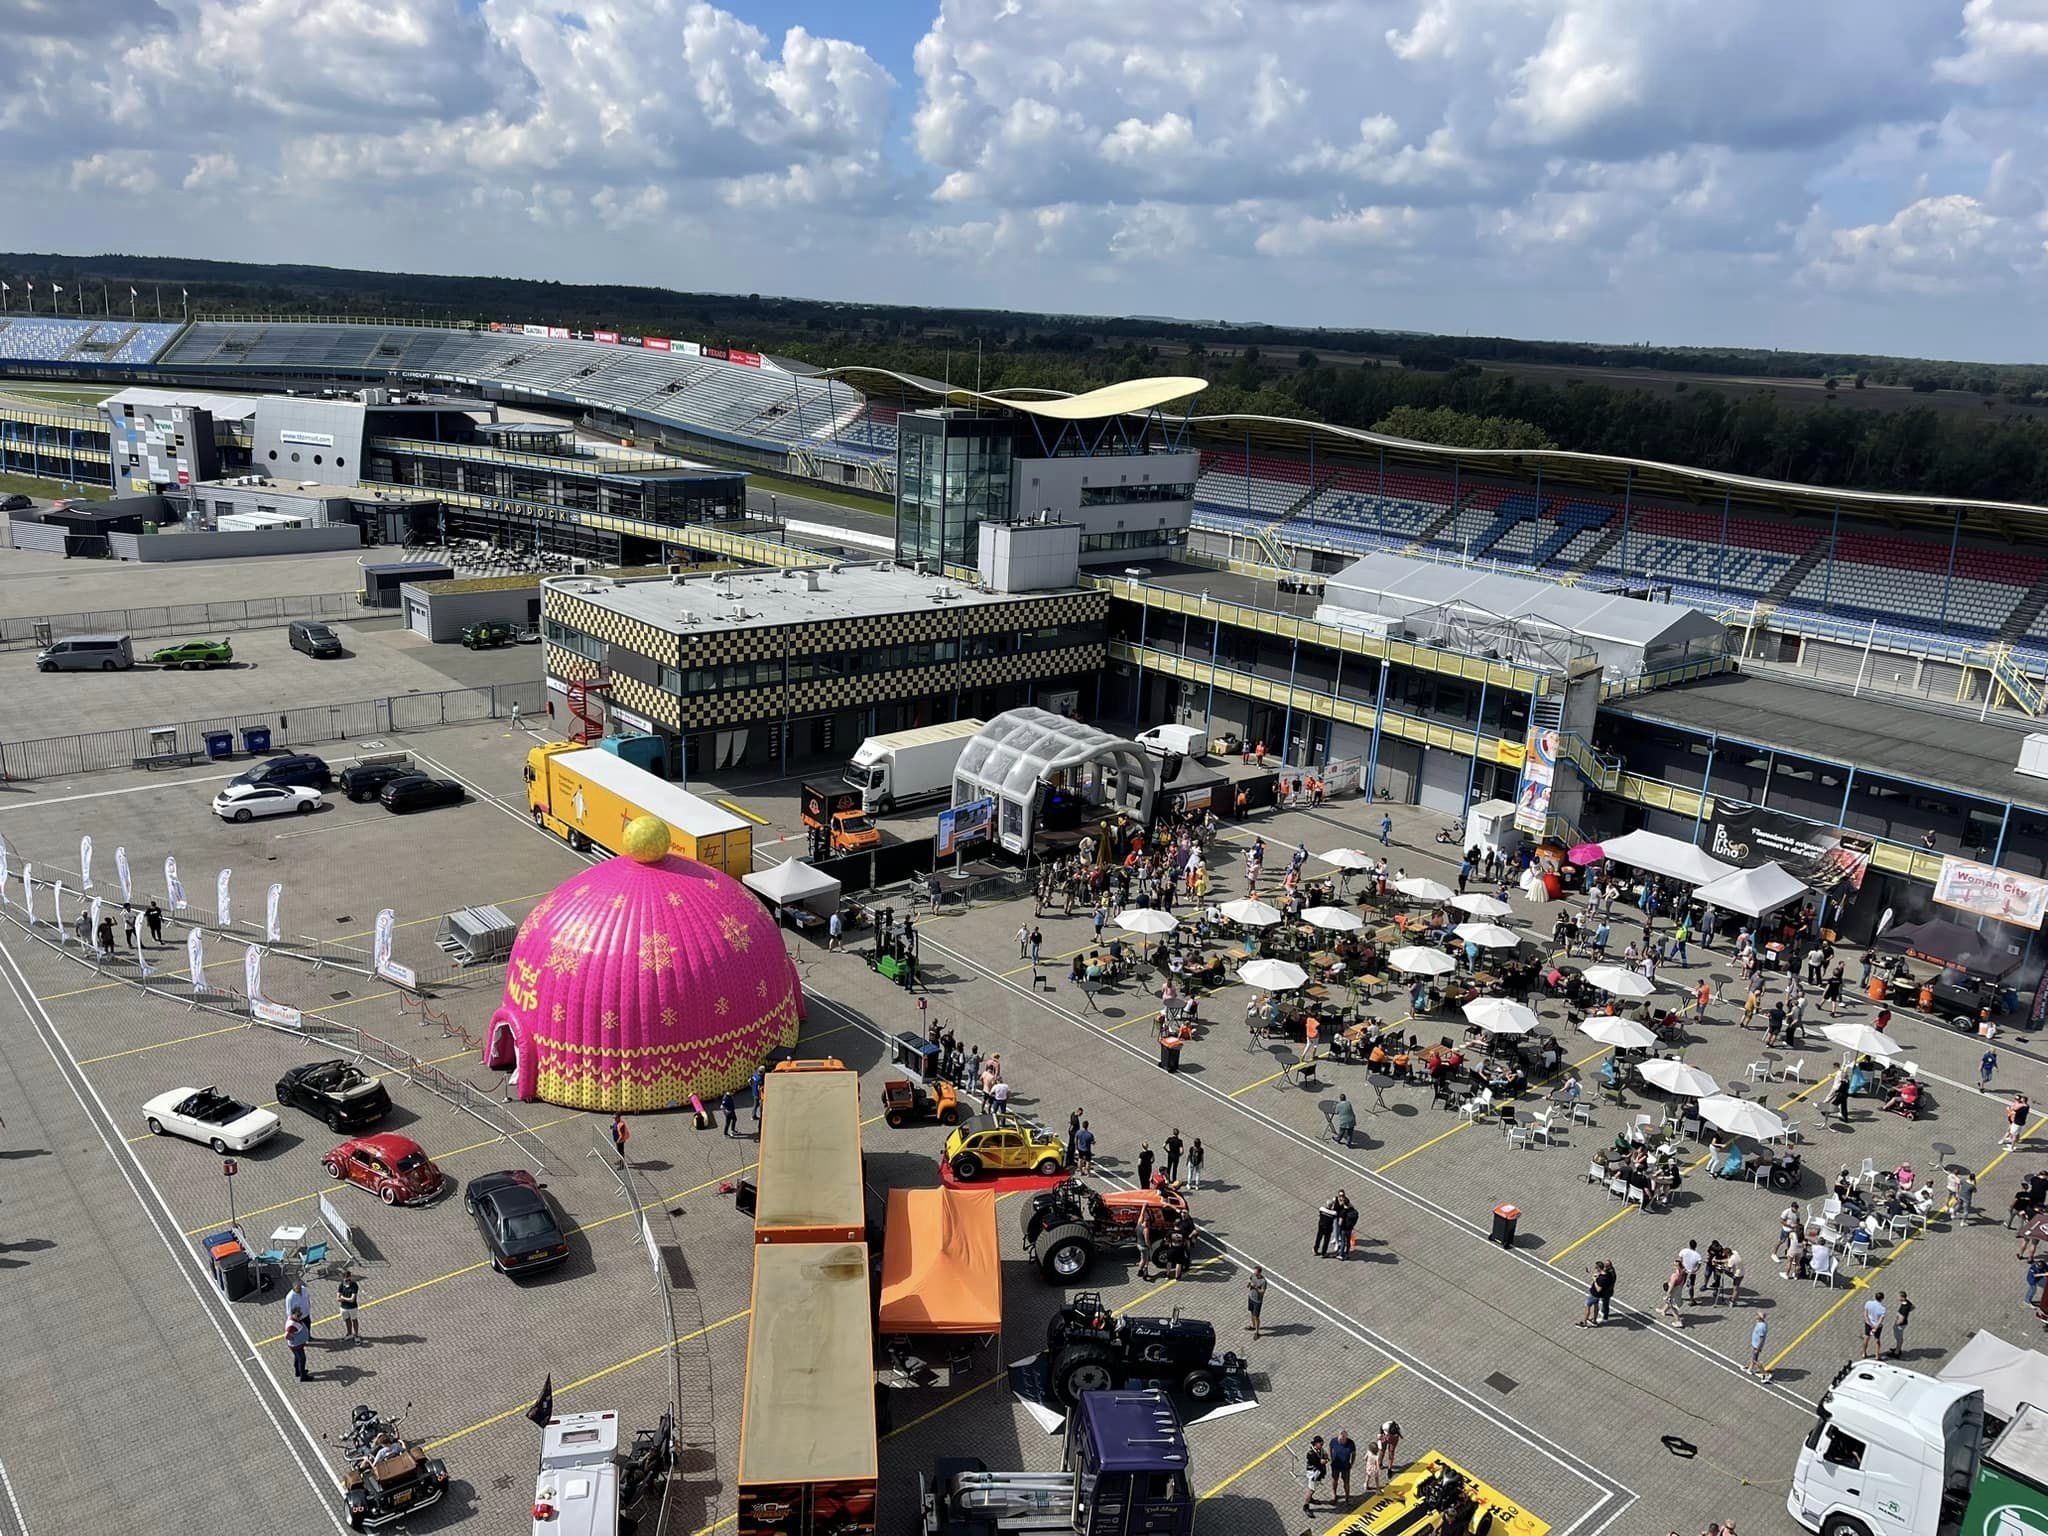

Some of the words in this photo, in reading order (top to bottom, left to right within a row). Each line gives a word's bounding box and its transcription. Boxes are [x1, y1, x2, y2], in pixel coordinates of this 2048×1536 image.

[708, 348, 727, 359] TEXACO
[492, 501, 568, 521] PADDOCK
[1466, 493, 1617, 570] TT
[1635, 538, 1792, 587] CIRCUIT
[1957, 871, 2001, 890] Woman
[2003, 882, 2029, 898] City
